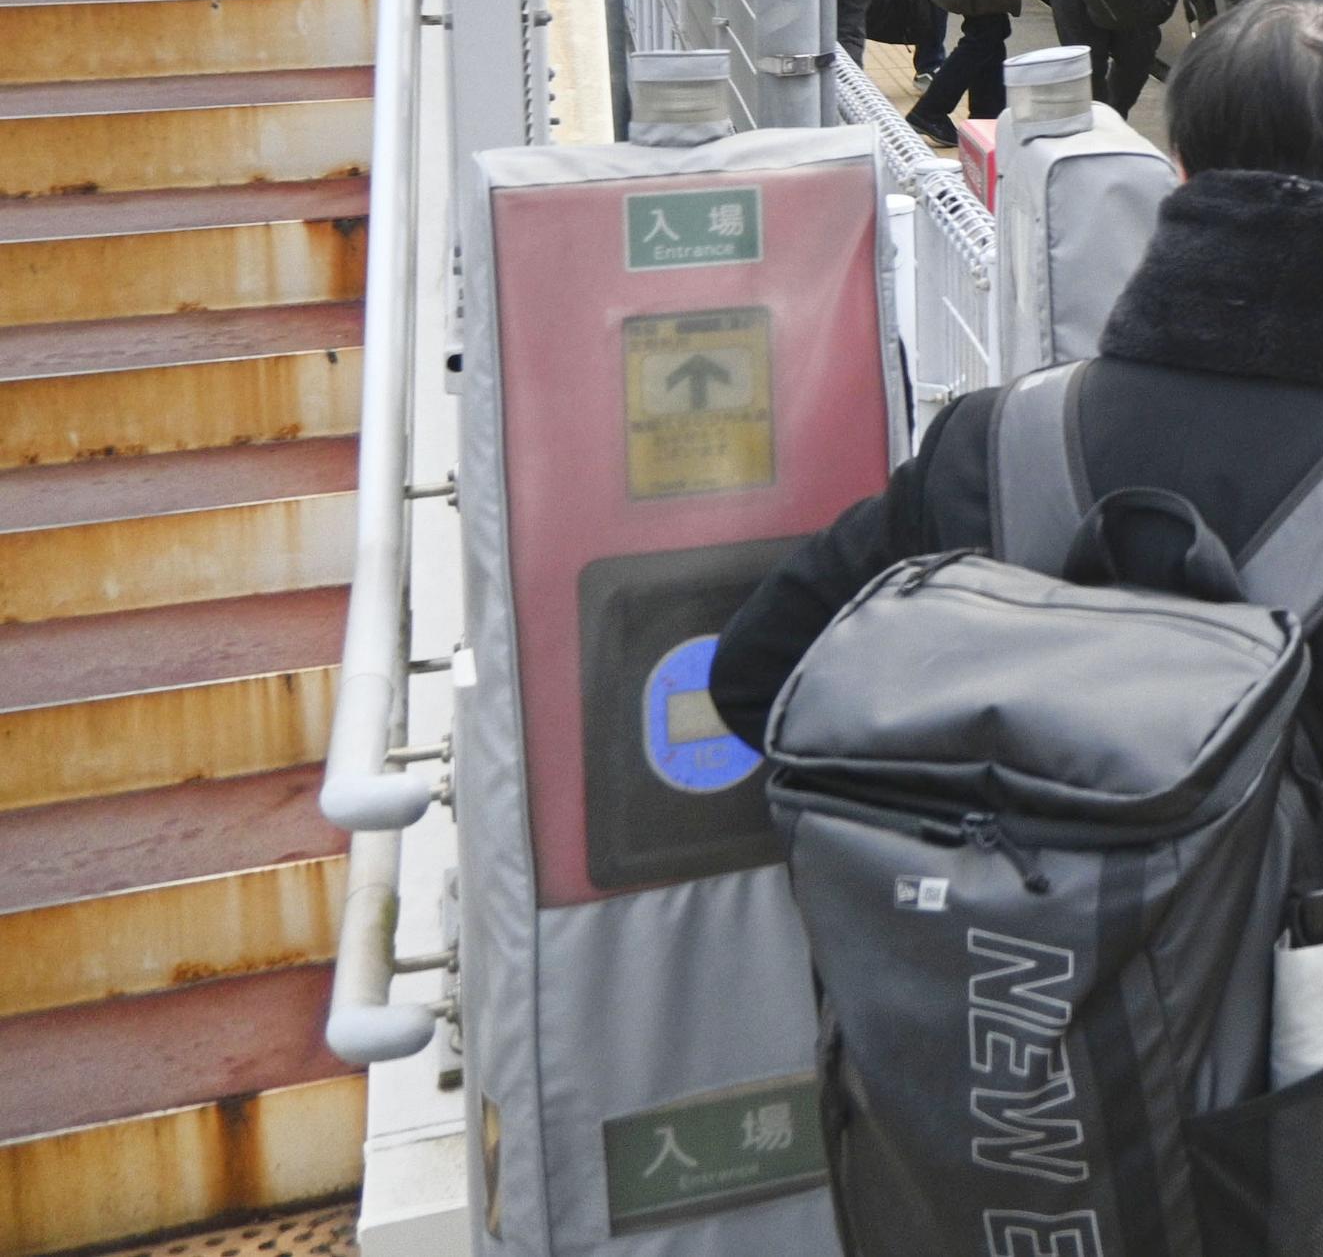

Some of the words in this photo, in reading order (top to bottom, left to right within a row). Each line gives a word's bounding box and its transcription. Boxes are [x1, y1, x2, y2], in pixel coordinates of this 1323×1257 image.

[643, 203, 744, 243] 入場
[654, 243, 736, 260] Entrance
[967, 927, 1089, 1184] NEW
[643, 1102, 793, 1178] 入場
